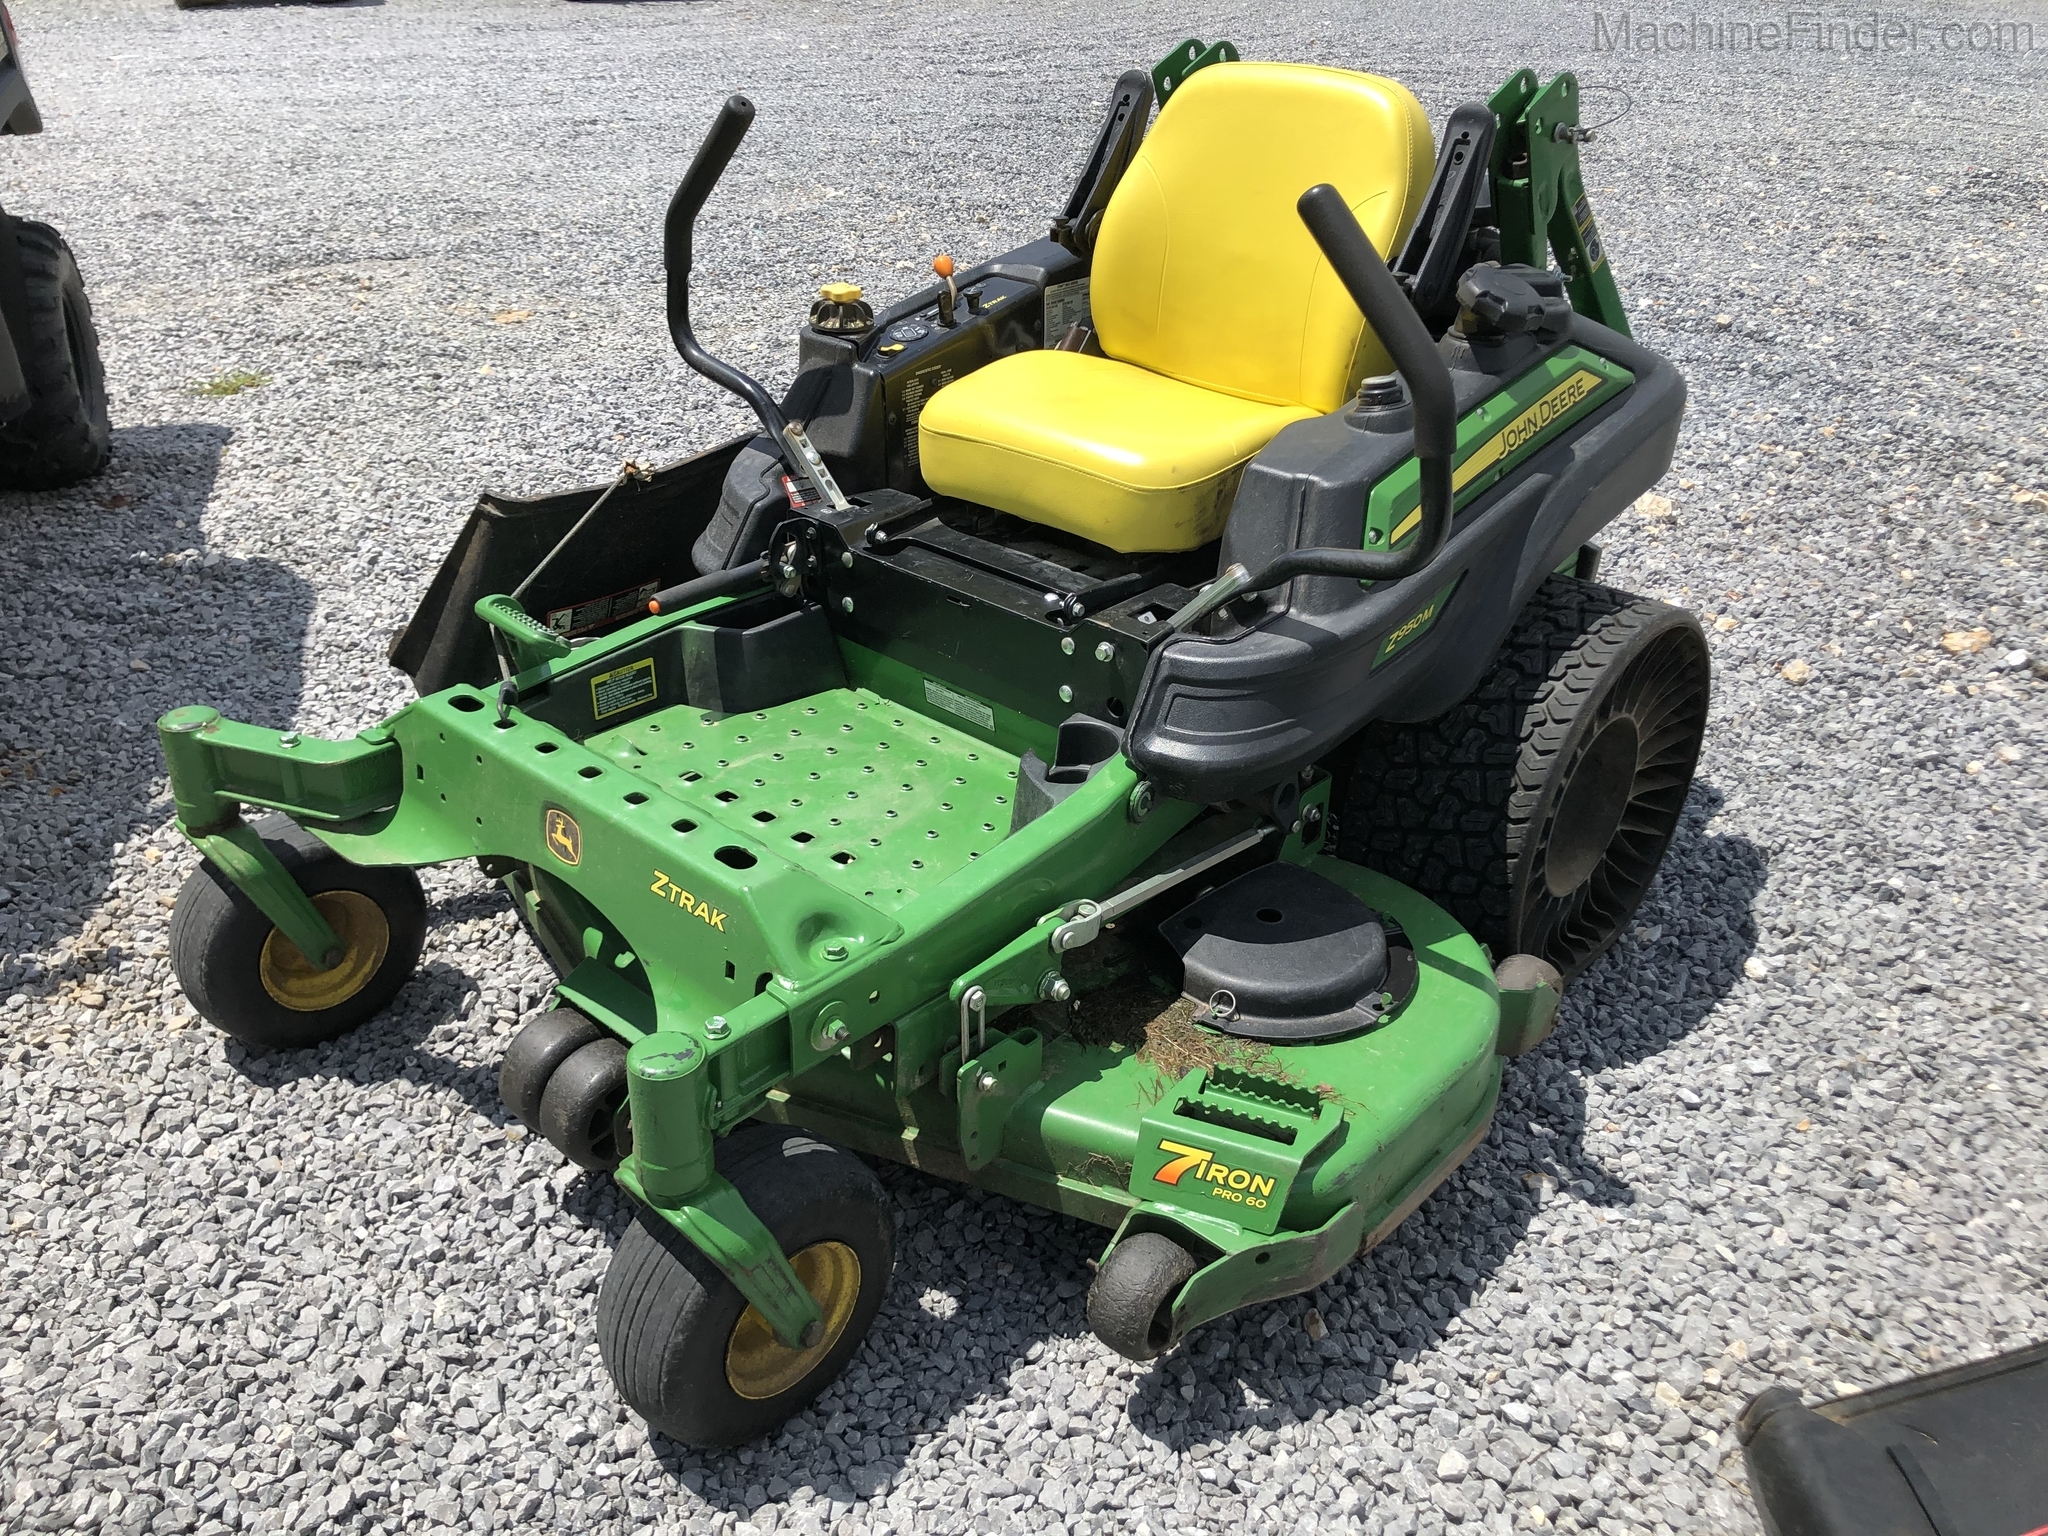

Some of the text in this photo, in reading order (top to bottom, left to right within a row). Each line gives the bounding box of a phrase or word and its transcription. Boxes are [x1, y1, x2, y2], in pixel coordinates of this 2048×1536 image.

[1498, 377, 1586, 457] JOHN DEERE
[1384, 604, 1435, 654] Z950M
[649, 868, 729, 934] ZTRAK
[1211, 1186, 1267, 1210] PRO 60
